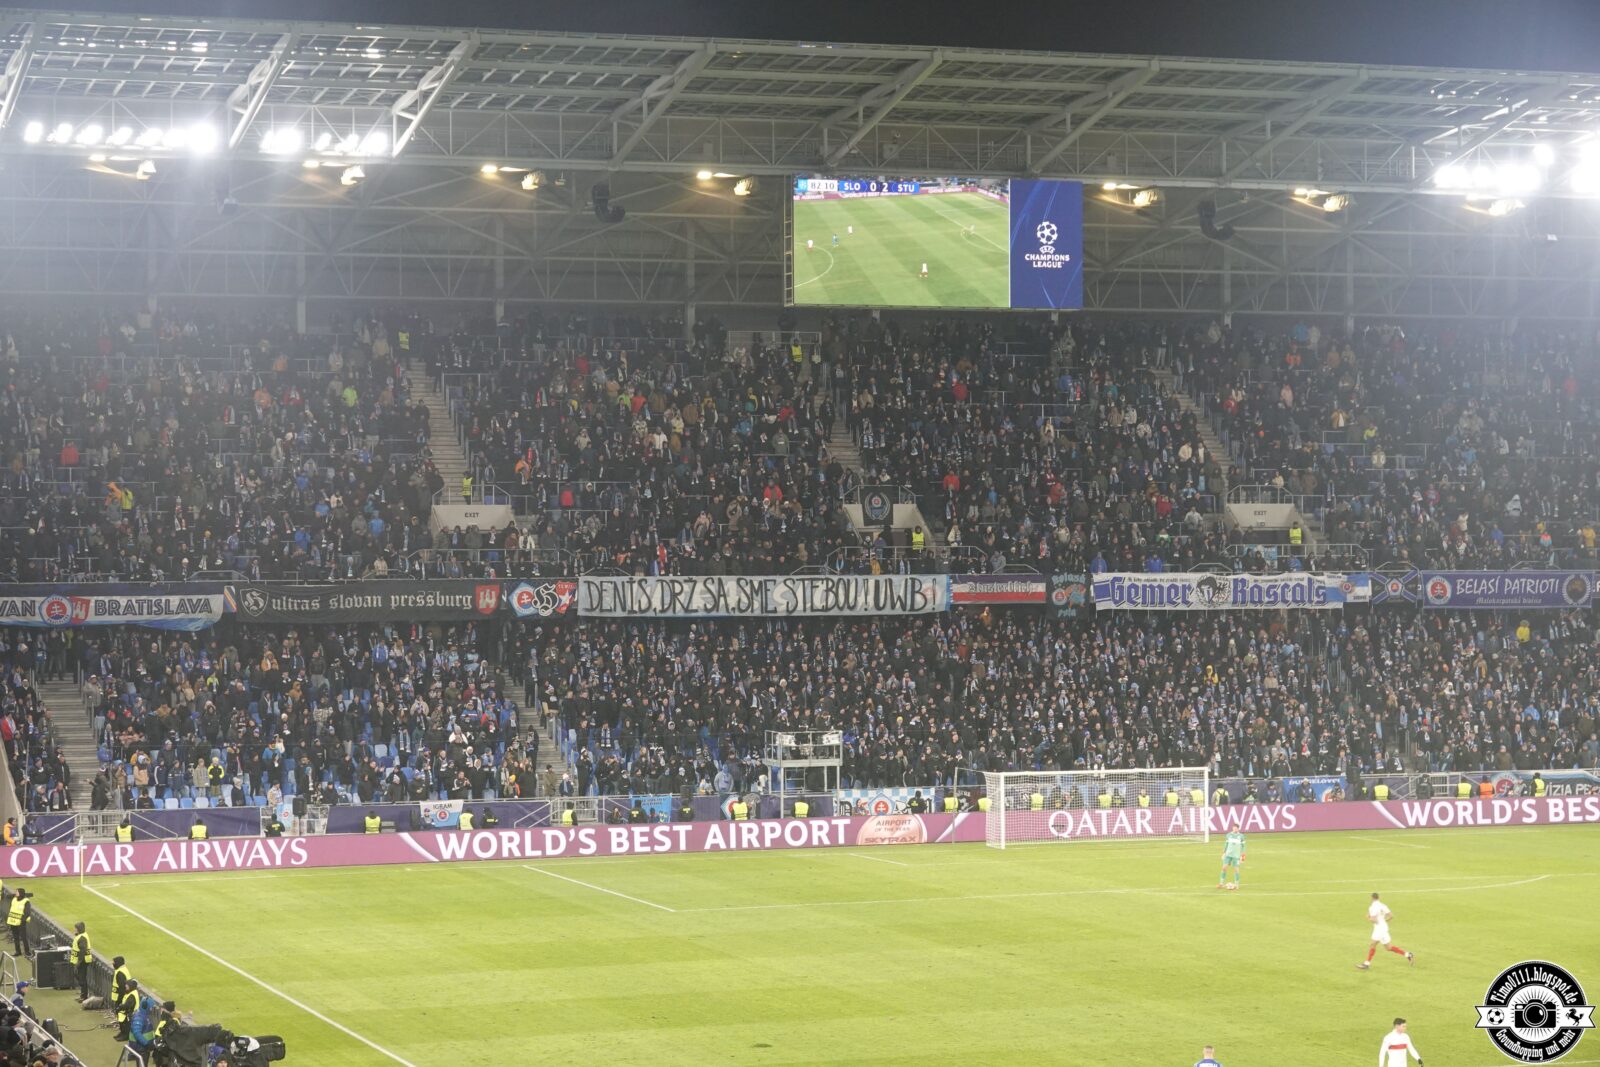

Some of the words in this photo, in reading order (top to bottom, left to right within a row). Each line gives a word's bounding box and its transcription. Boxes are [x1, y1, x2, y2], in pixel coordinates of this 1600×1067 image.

[843, 182, 861, 191] SLO
[869, 182, 877, 192] 0
[882, 182, 889, 192] 2
[897, 183, 915, 192] STU
[1024, 253, 1070, 261] CHAMPIONS
[1110, 576, 1195, 608] Gemer
[1231, 576, 1329, 608] Rascals
[1455, 575, 1501, 595] BELASÍ
[1504, 578, 1560, 595] PATRIOTI
[94, 597, 213, 617] BRATISLAVA
[271, 597, 321, 612] ultras
[329, 593, 383, 610] slovan
[389, 590, 473, 610] pressburg
[1048, 807, 1154, 838] QATAR
[1167, 804, 1298, 834] AIRWAYS
[1402, 797, 1539, 827] WORLD'S
[435, 827, 598, 861] WORLD'S
[607, 823, 693, 854] BEST
[704, 818, 851, 850] AIRPORT
[863, 836, 917, 844] SKYTRAX
[9, 842, 137, 877] QATAR
[153, 837, 309, 871] AIRWAYS
